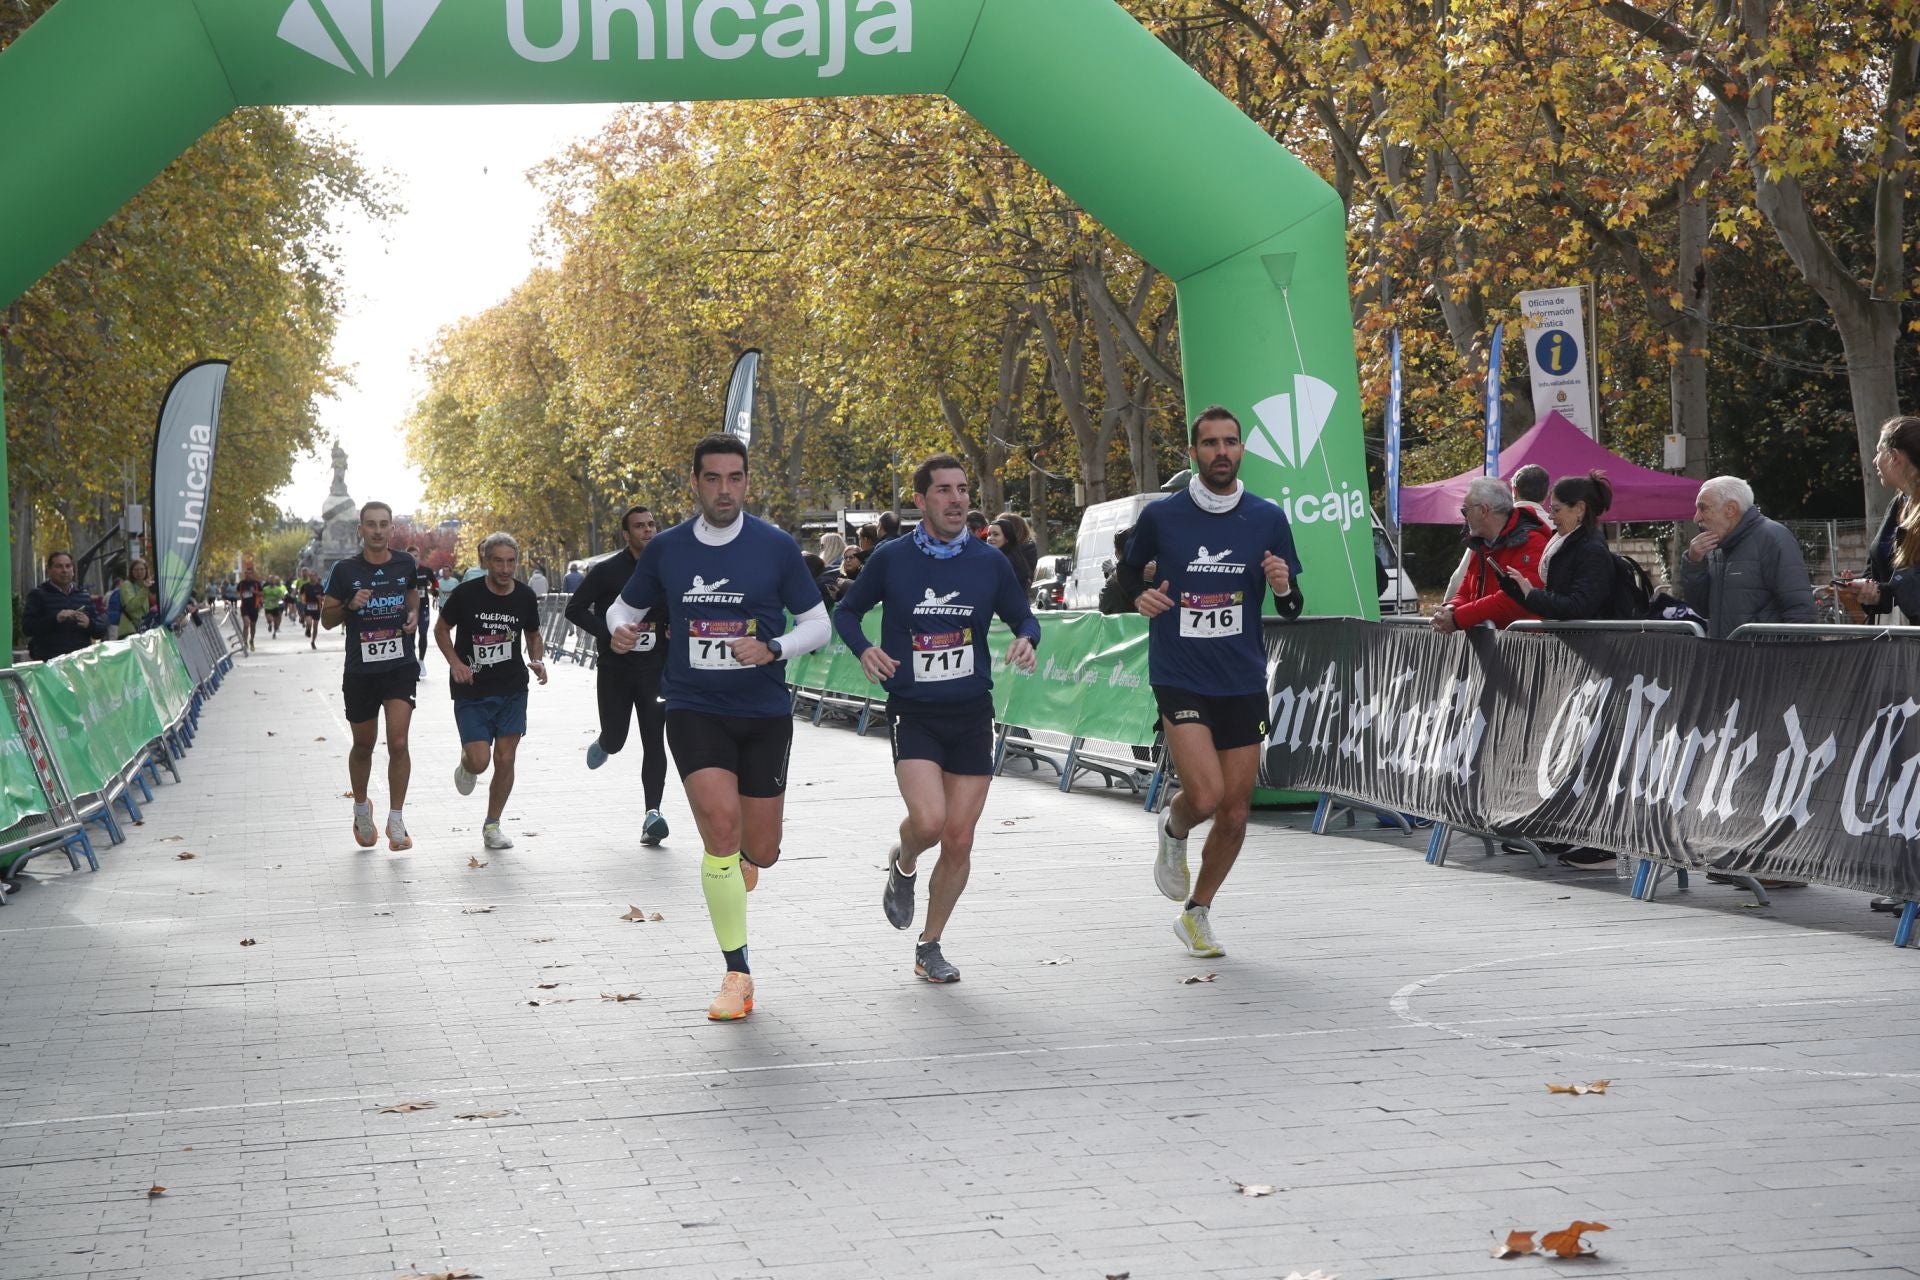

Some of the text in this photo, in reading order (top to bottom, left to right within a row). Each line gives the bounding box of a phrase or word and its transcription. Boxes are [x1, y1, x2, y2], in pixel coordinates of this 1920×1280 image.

[1528, 298, 1554, 308] Oficina
[1264, 481, 1365, 532] icaja
[1186, 564, 1246, 574] MICHELIN
[682, 595, 744, 604] MICHELIN
[913, 607, 973, 617] MICHELIN
[1189, 609, 1233, 629] 716
[368, 640, 397, 656] 873
[478, 644, 504, 659] 871
[698, 639, 737, 660] 71
[921, 649, 964, 672] 717
[1265, 660, 1342, 755] orte
[1607, 674, 1758, 824] Norte
[1760, 703, 1837, 831] de
